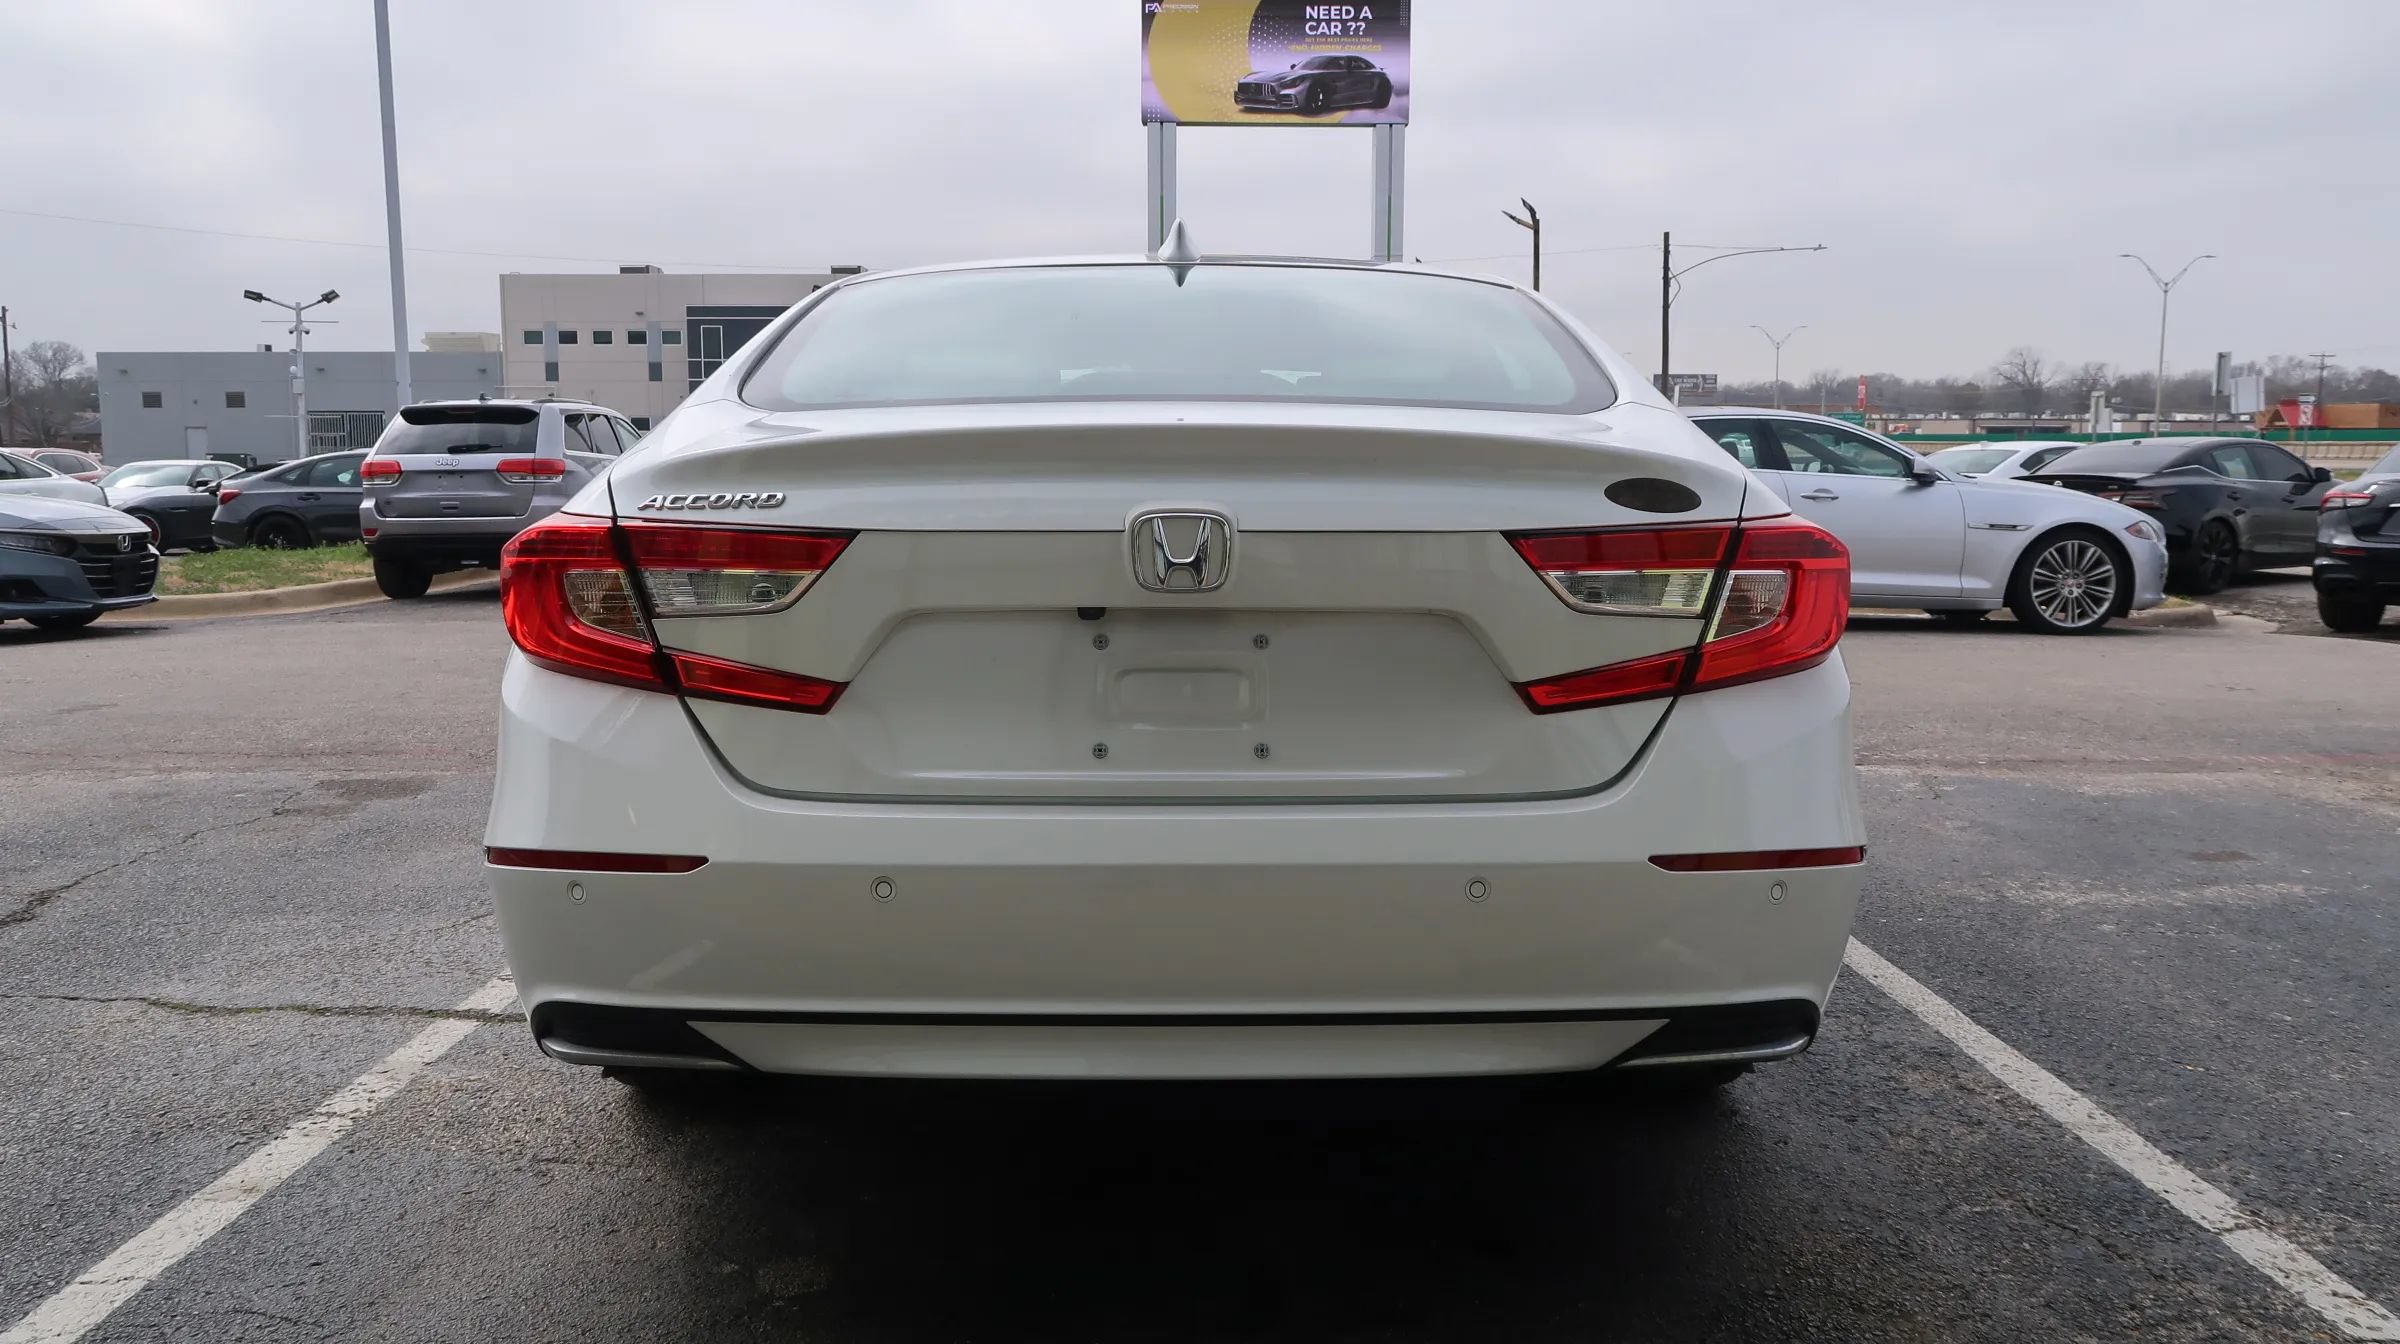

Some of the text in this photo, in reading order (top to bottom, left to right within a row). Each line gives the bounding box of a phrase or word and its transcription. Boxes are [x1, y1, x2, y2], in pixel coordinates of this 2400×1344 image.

[1306, 5, 1373, 19] NEED A
[1305, 21, 1366, 35] CAR ??
[436, 457, 460, 467] Jeep
[637, 492, 786, 511] ACCORD
